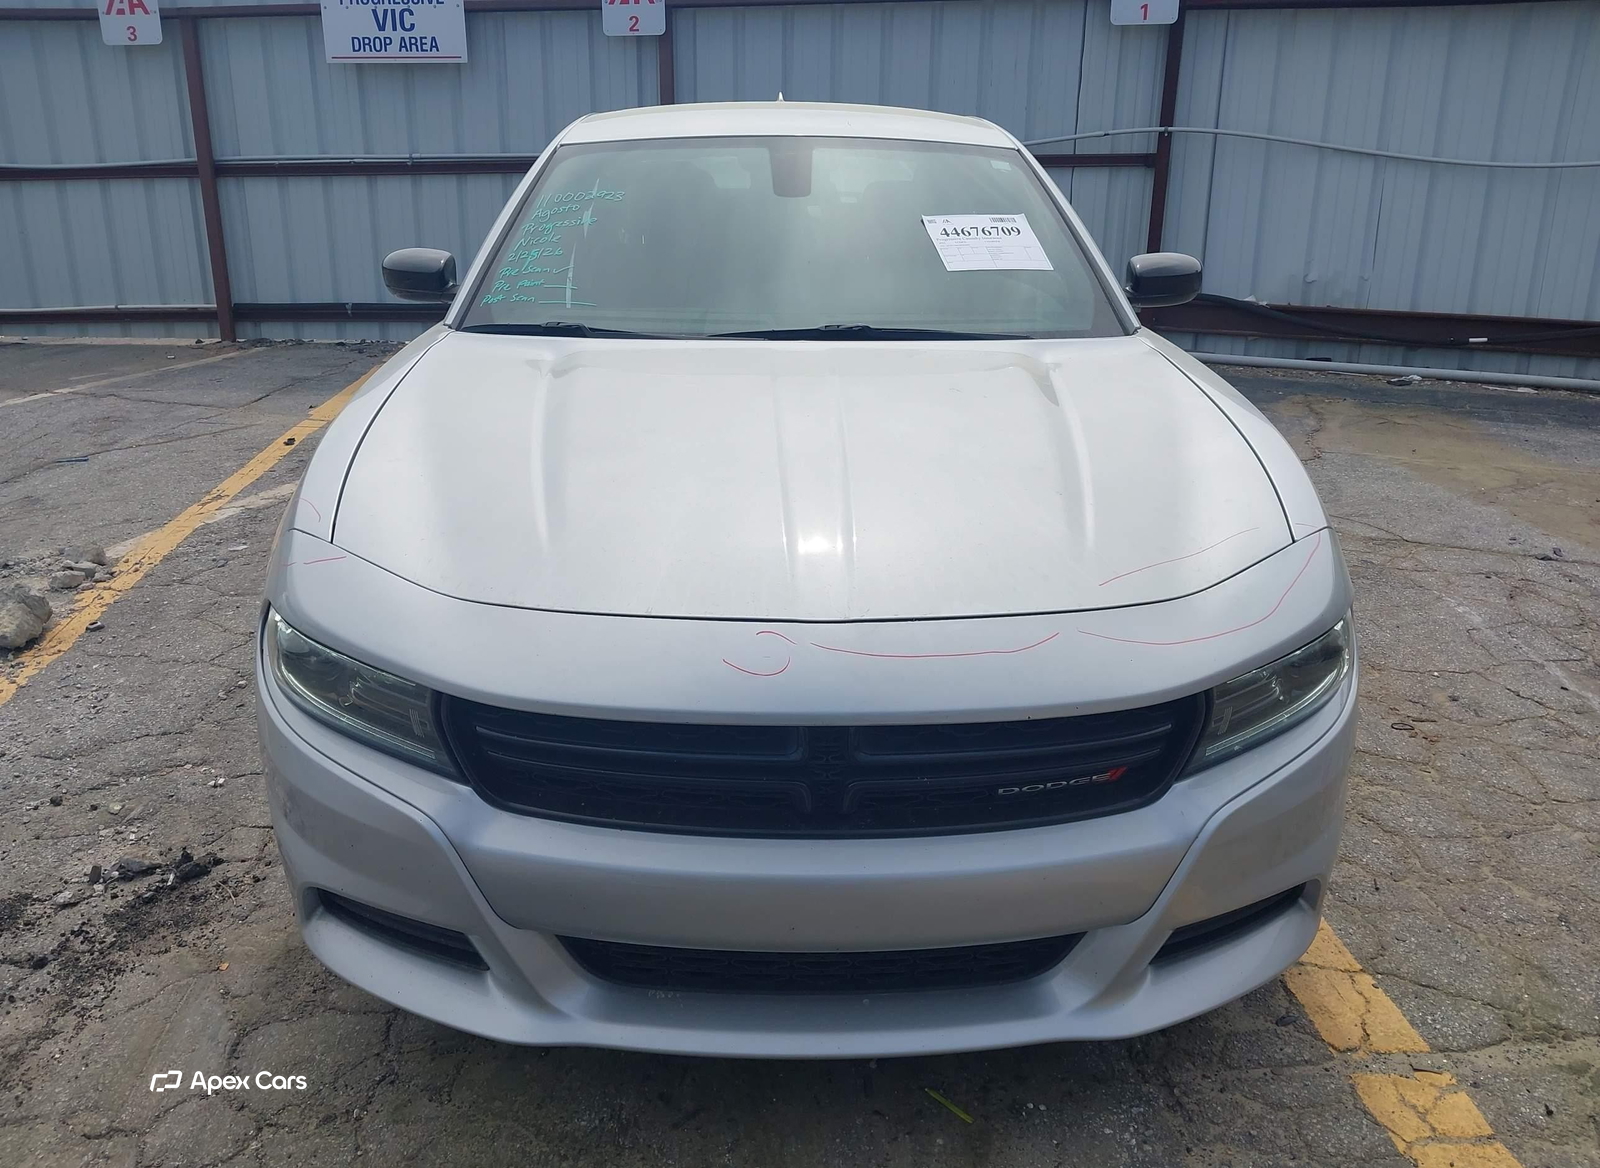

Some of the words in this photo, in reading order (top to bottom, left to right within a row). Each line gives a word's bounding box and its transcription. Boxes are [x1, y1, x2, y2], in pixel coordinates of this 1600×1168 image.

[371, 8, 416, 32] VIC
[1140, 3, 1149, 21] 1
[628, 15, 640, 32] 2
[126, 25, 138, 42] 3
[351, 36, 393, 53] DROP
[398, 36, 440, 53] AREA
[531, 204, 581, 222] Agosto
[940, 225, 1021, 238] 44676709
[514, 232, 562, 252] Nicole
[499, 267, 519, 278] Pre
[492, 280, 511, 293] Pre
[998, 772, 1111, 796] DODGE
